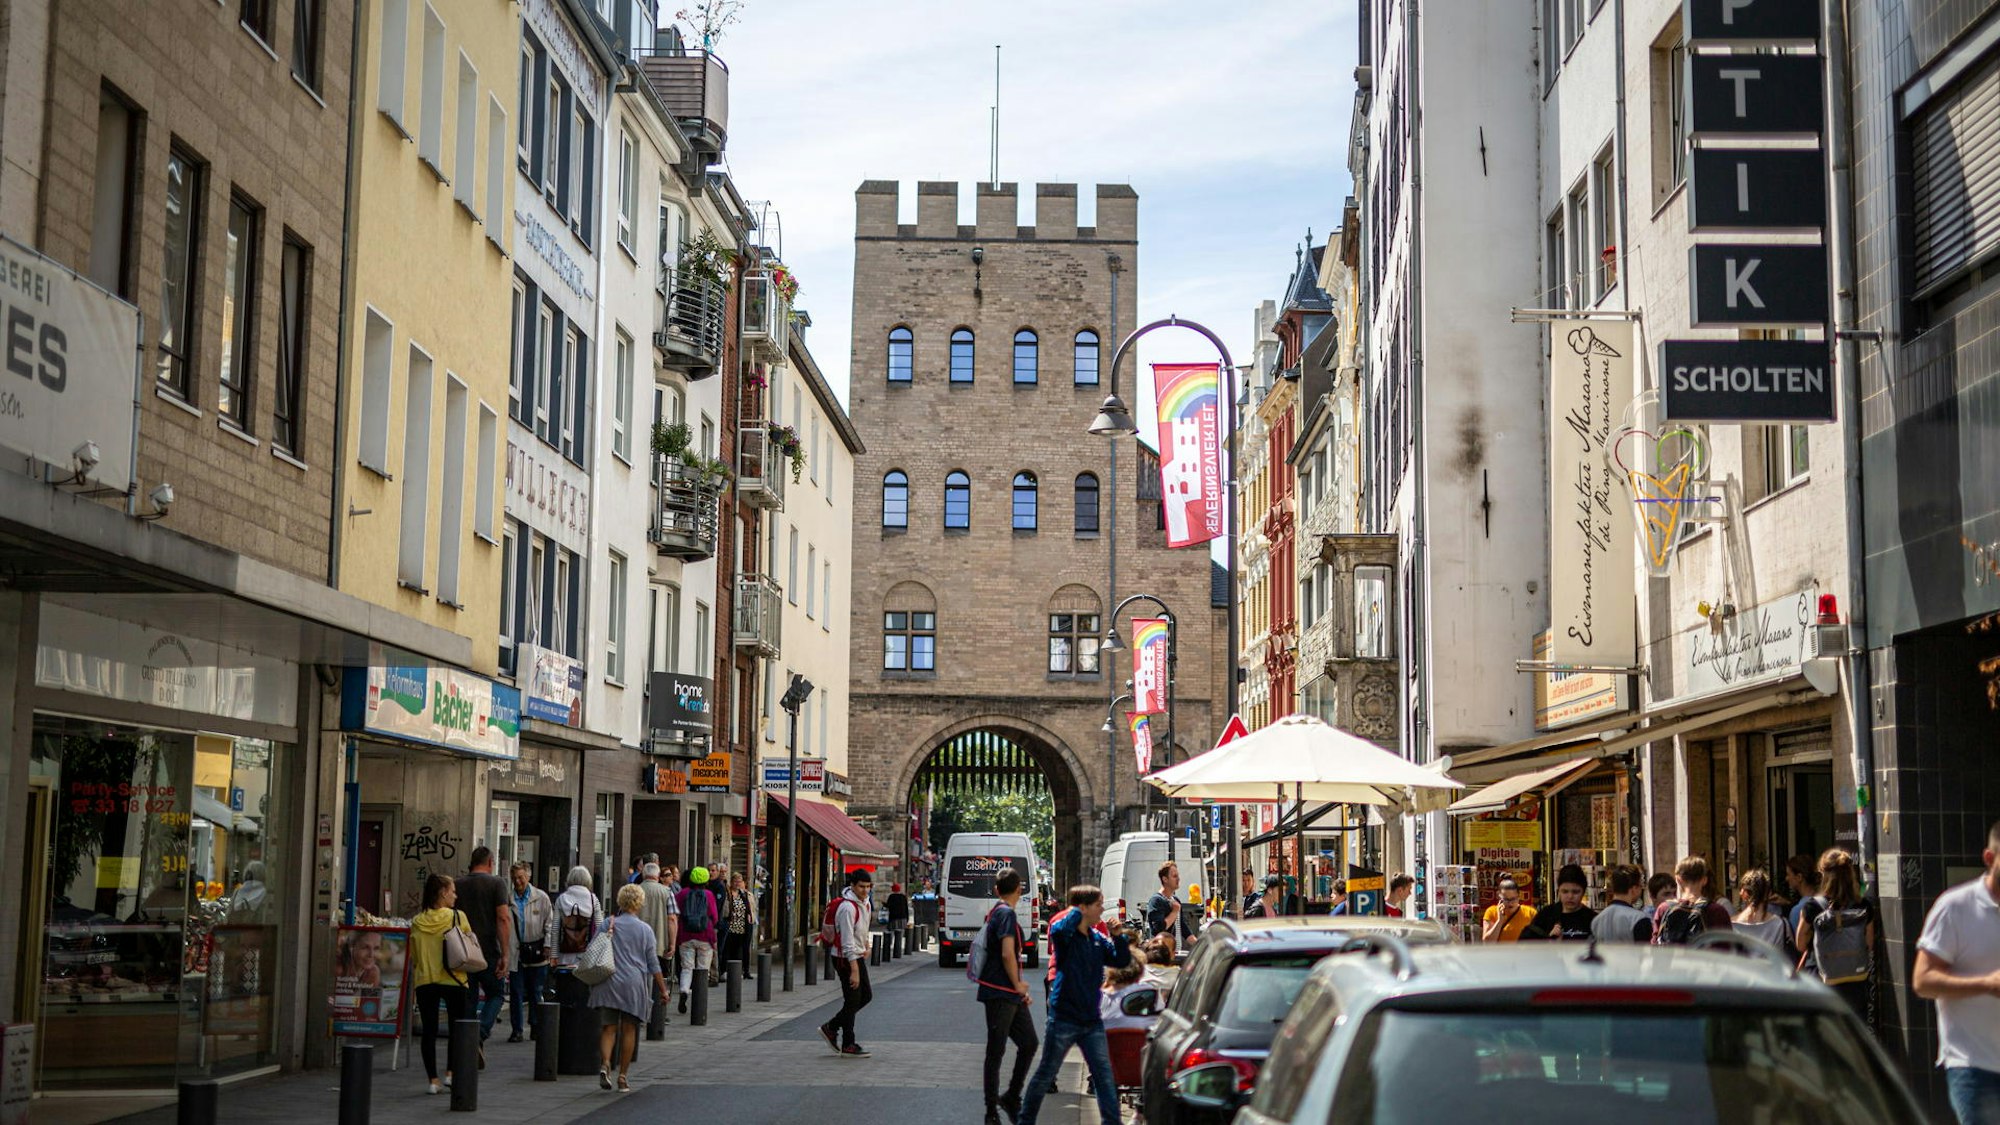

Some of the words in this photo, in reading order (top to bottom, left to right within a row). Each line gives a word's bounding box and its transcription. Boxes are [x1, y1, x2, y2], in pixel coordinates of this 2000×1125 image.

[0, 302, 67, 393] ES
[1673, 366, 1824, 393] SCHOLTEN
[506, 441, 587, 536] WILLECKE
[674, 680, 703, 698] home
[697, 759, 724, 767] CASITA
[803, 763, 822, 777] EXPRESS
[692, 769, 729, 777] MEXICANA
[72, 782, 176, 799] Party-Service
[96, 800, 115, 813] 33
[121, 800, 139, 813] 18
[1212, 806, 1219, 824] P
[1481, 848, 1520, 859] Digitale
[1477, 858, 1531, 869] Passbilder
[1356, 893, 1370, 913] P
